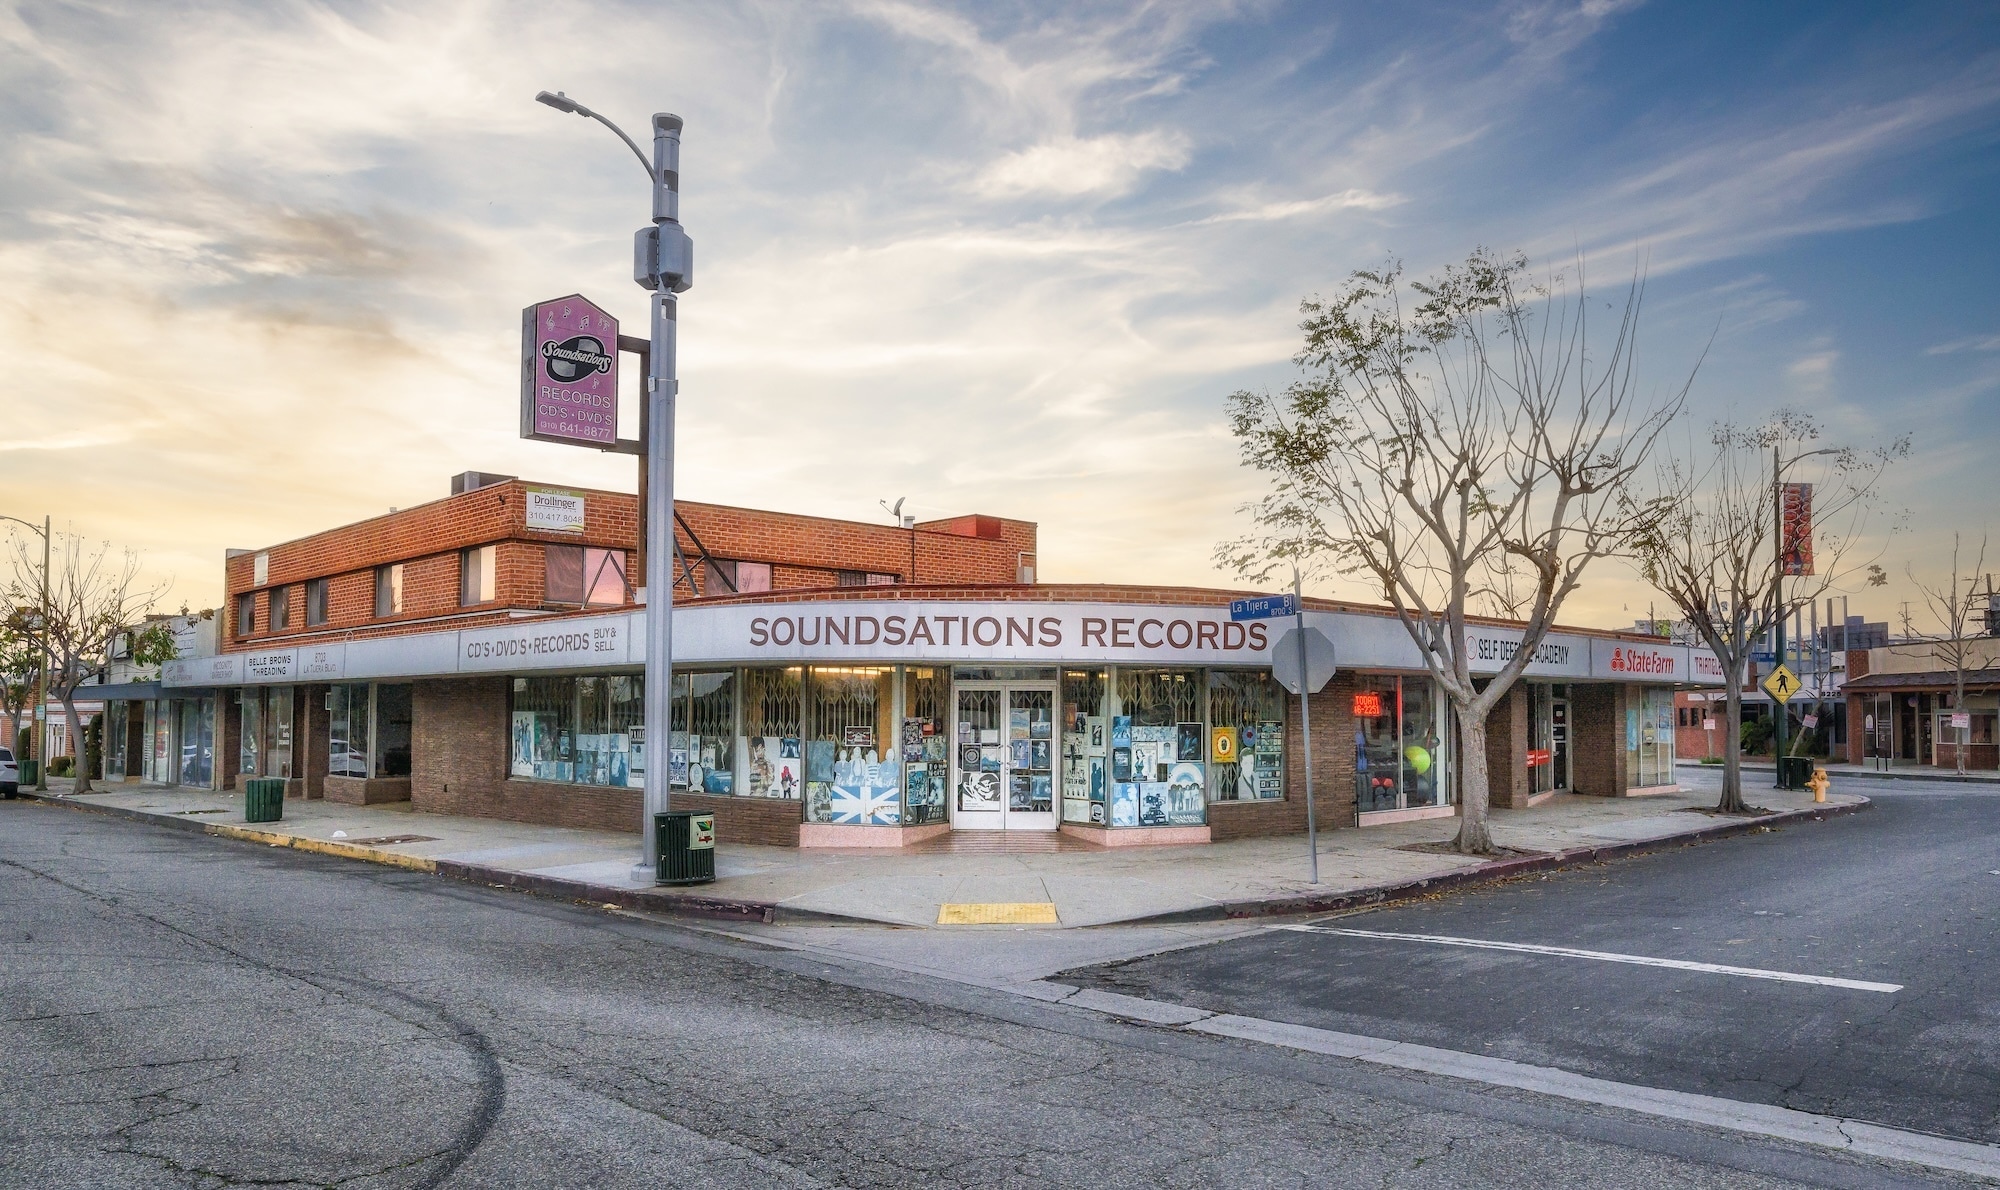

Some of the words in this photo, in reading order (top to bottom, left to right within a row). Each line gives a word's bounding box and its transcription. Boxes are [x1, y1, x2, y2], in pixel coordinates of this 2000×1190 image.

[542, 341, 612, 373] Soundsations
[541, 385, 611, 409] RECORDS
[559, 421, 611, 438] 641-8877
[534, 495, 576, 510] Drollinger
[528, 511, 583, 524] 310.417.8048
[1232, 602, 1242, 613] La
[1245, 600, 1269, 614] Tijera
[1283, 596, 1292, 608] Bl
[1271, 607, 1285, 616] 8700
[749, 616, 1064, 648] SOUNDSATIONS
[1081, 617, 1269, 652] RECORDS
[467, 641, 490, 659] CD'S
[496, 638, 527, 657] DVD'S
[533, 632, 590, 654] RECORDS
[594, 641, 615, 652] SELL
[1478, 638, 1498, 660] SELF
[1534, 643, 1570, 665] ACADEMY
[249, 657, 267, 667] BELLE
[270, 655, 291, 665] BROWS
[253, 667, 287, 677] THREADING
